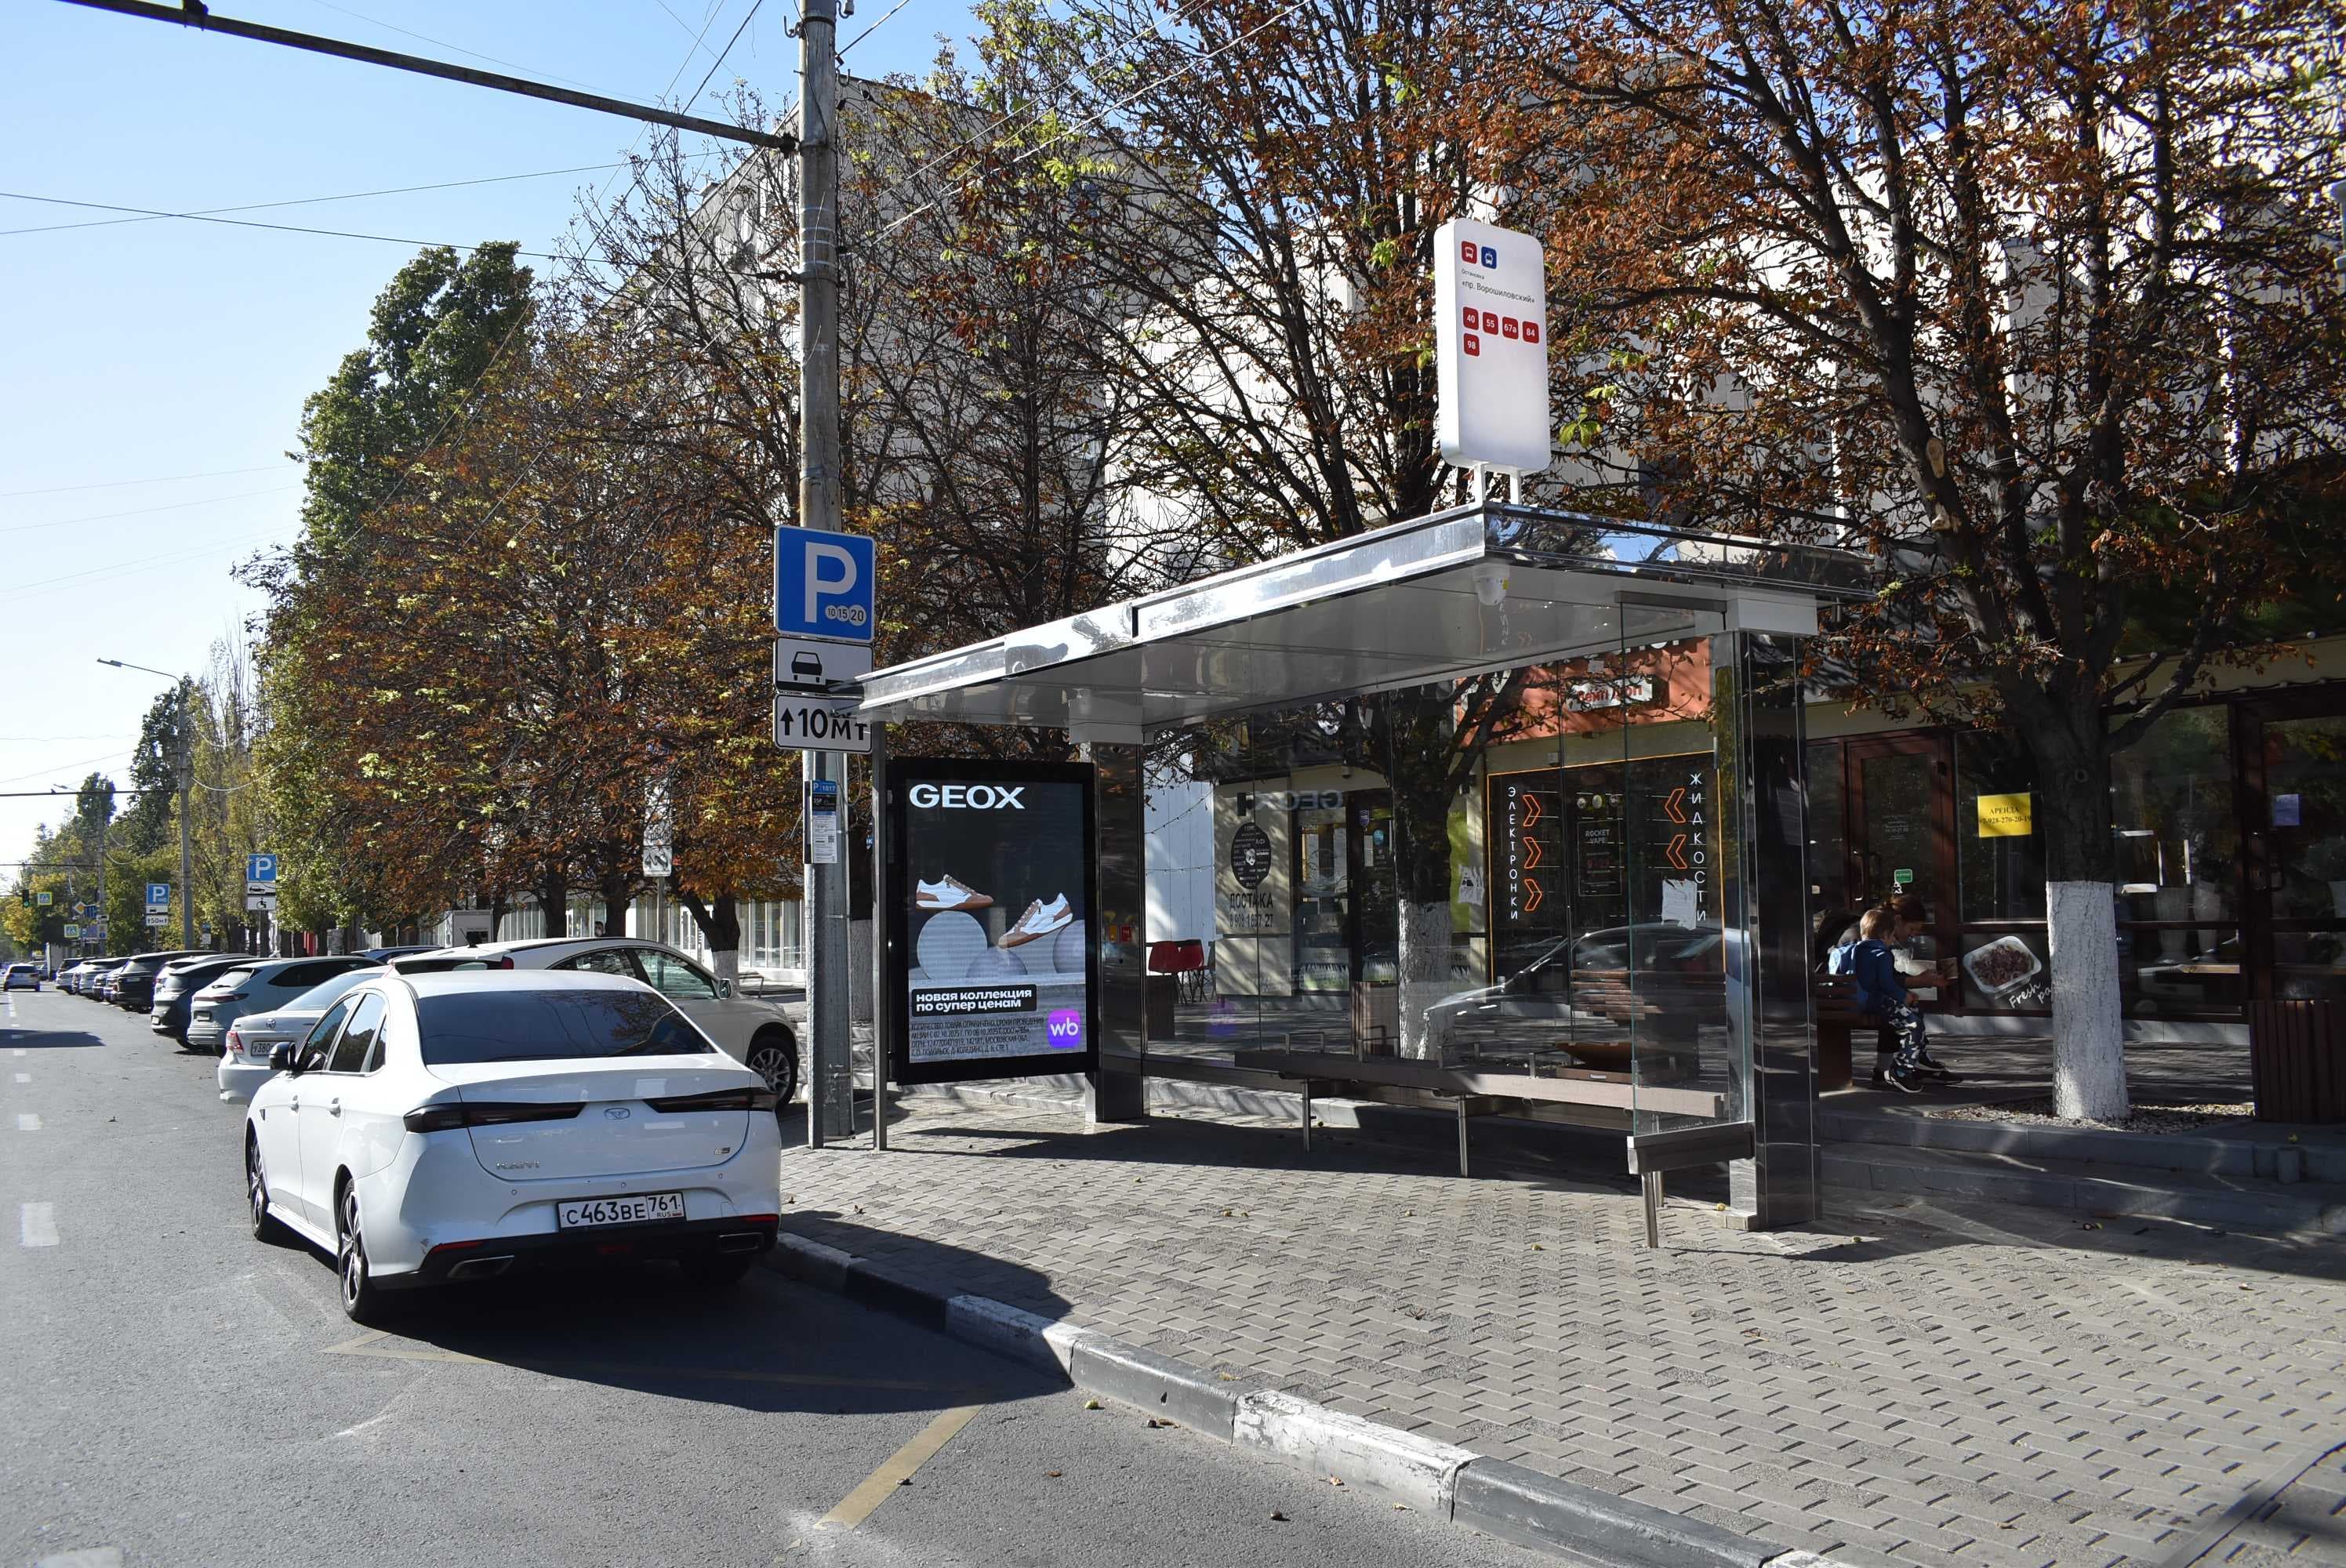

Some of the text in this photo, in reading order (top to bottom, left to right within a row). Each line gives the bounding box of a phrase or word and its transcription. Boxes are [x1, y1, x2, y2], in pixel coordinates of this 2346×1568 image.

[1467, 314, 1476, 324] 40
[1486, 319, 1495, 328] 55
[1526, 328, 1535, 337] 84
[1467, 340, 1476, 350] 98
[804, 541, 857, 623] P
[827, 608, 864, 622] 10 15 20
[909, 783, 1026, 809] GEOX
[1507, 786, 1519, 920] ЭЛЕКТРОНКИ
[1690, 773, 1707, 922] ЖИДКОСТИ
[256, 857, 272, 879] P
[153, 887, 165, 902] P
[916, 989, 1032, 1002] новая коллекция
[916, 999, 1022, 1013] по супер ценам
[2008, 982, 2042, 1009] Fresh
[1050, 1017, 1079, 1037] wb
[252, 1041, 274, 1054] У380
[566, 1195, 678, 1225] С463ВЕ 761
